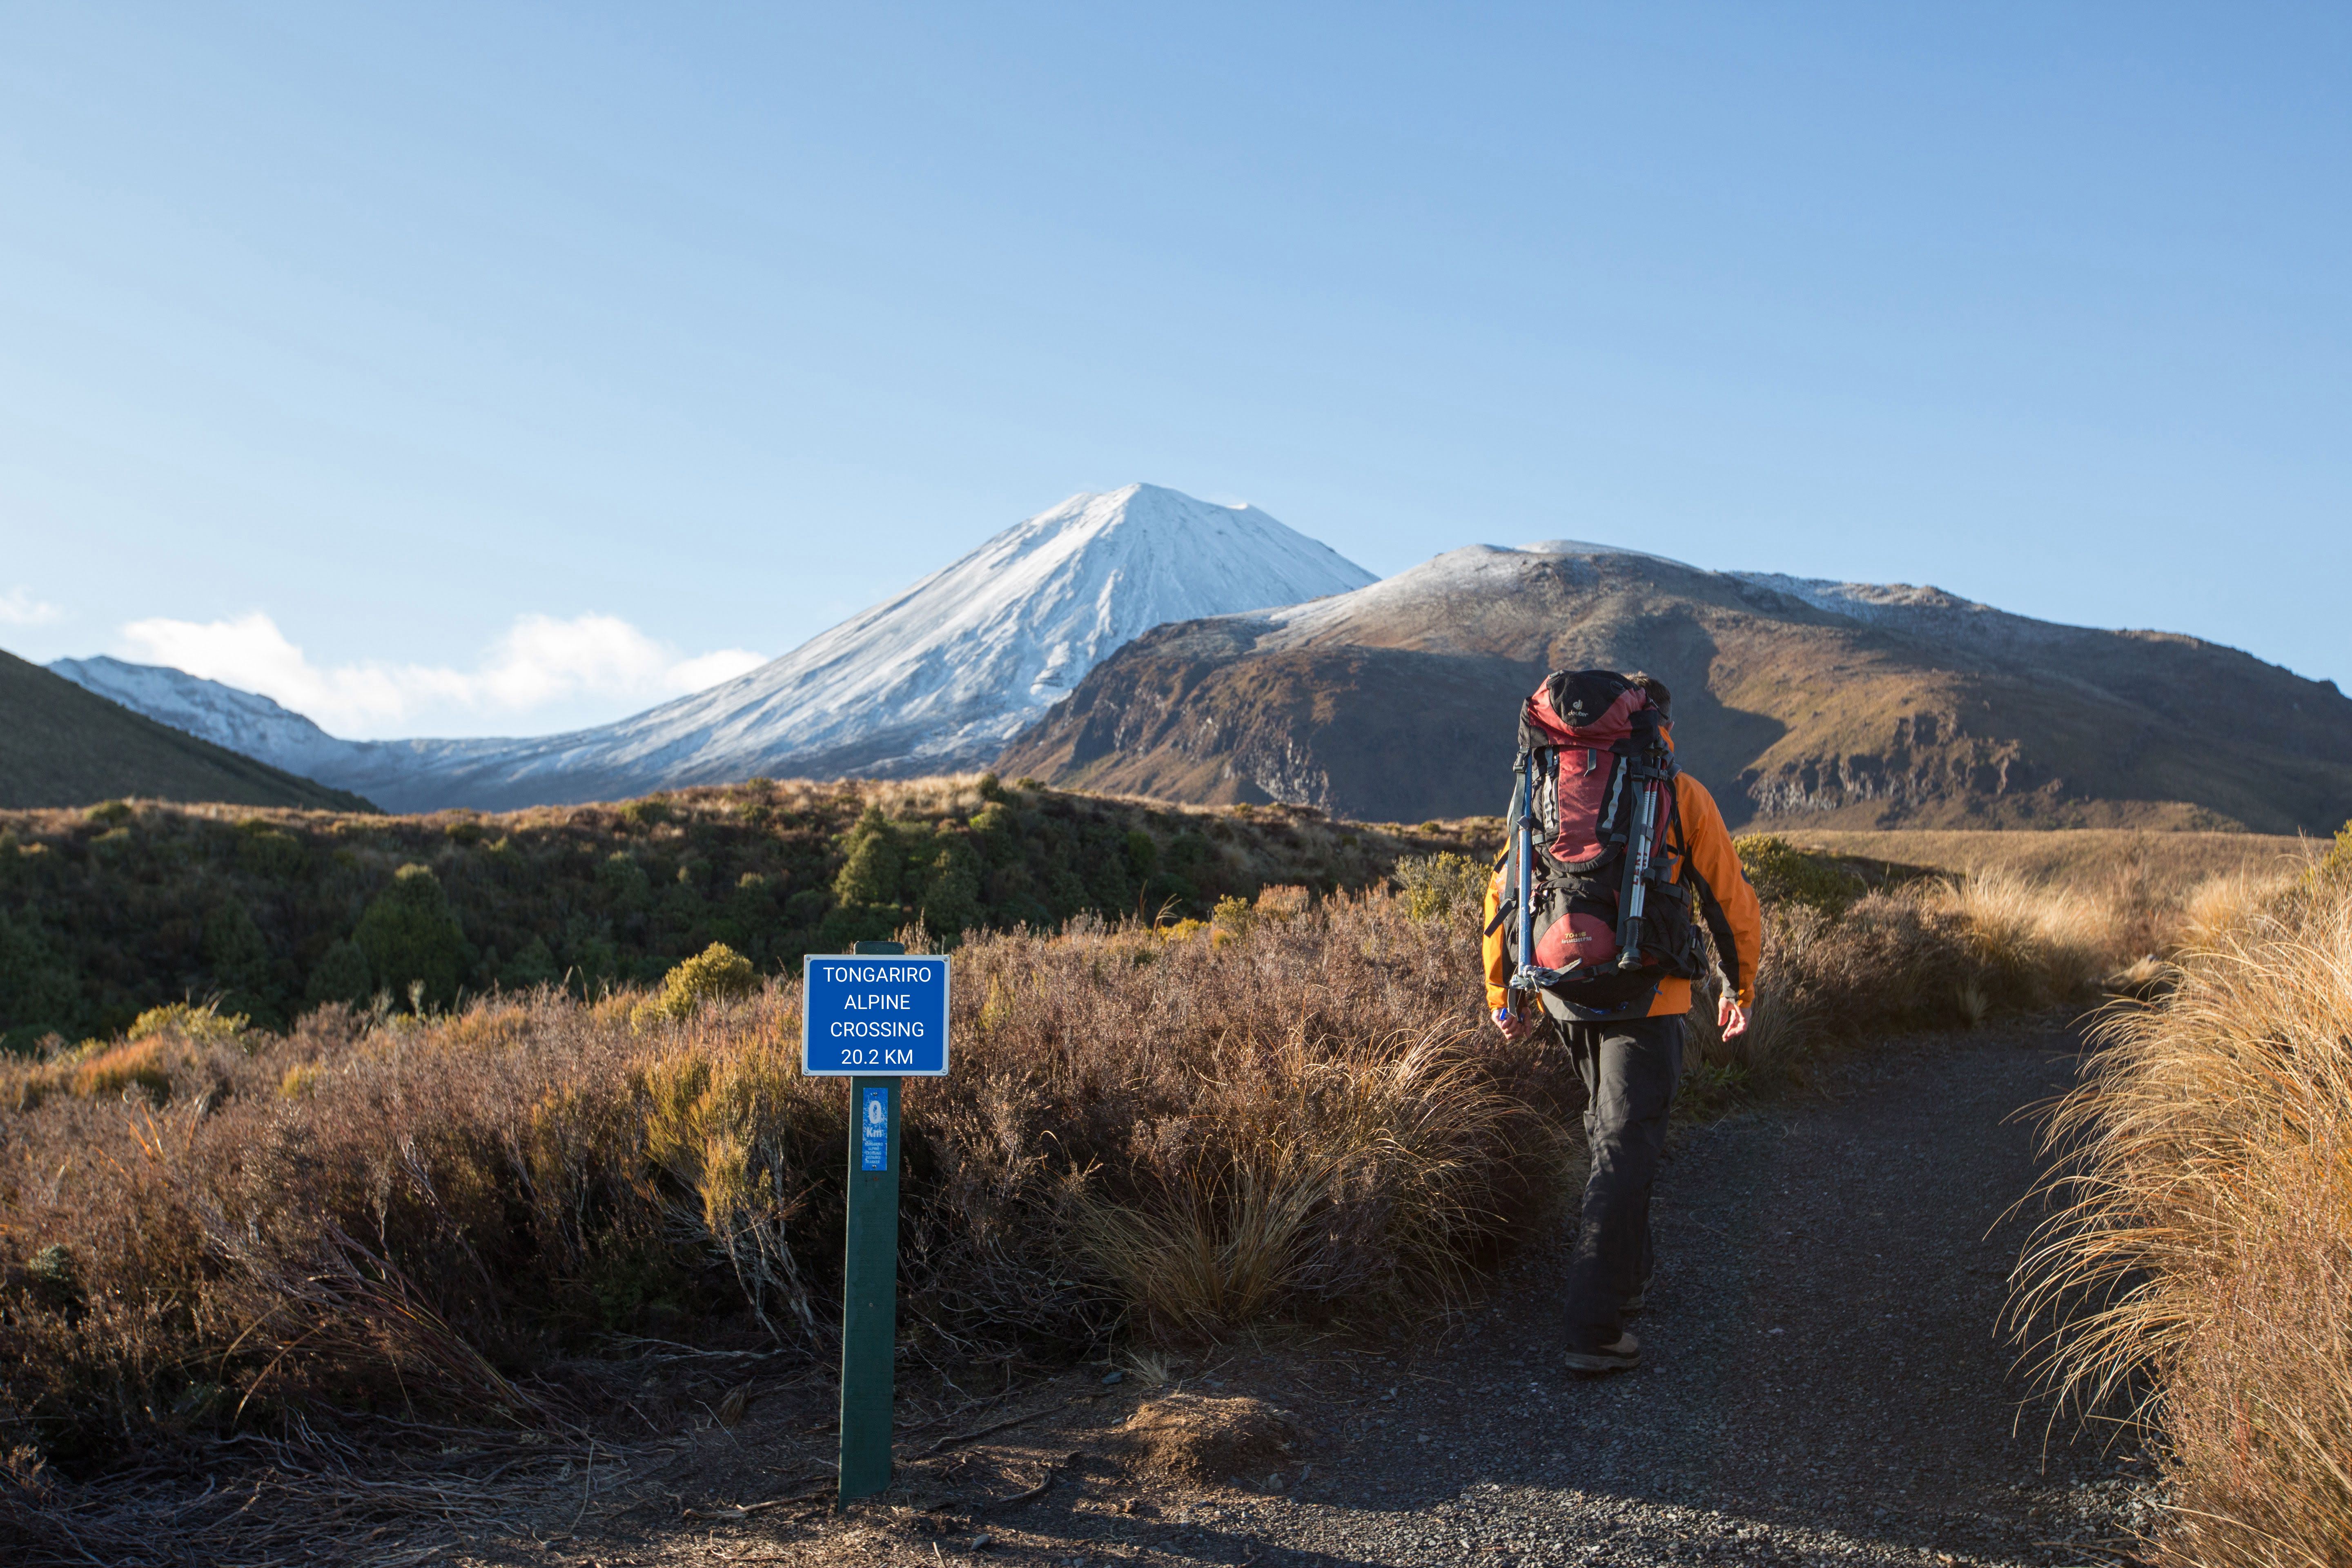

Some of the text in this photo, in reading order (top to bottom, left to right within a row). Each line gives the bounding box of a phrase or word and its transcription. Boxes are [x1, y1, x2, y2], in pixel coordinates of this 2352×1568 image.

[823, 967, 931, 982] TONGARIRO
[844, 995, 910, 1009] ALPINE
[831, 1022, 924, 1037] CROSSING
[842, 1049, 913, 1064] 20.2 KM
[869, 1100, 881, 1124] 0
[866, 1127, 882, 1138] Km
